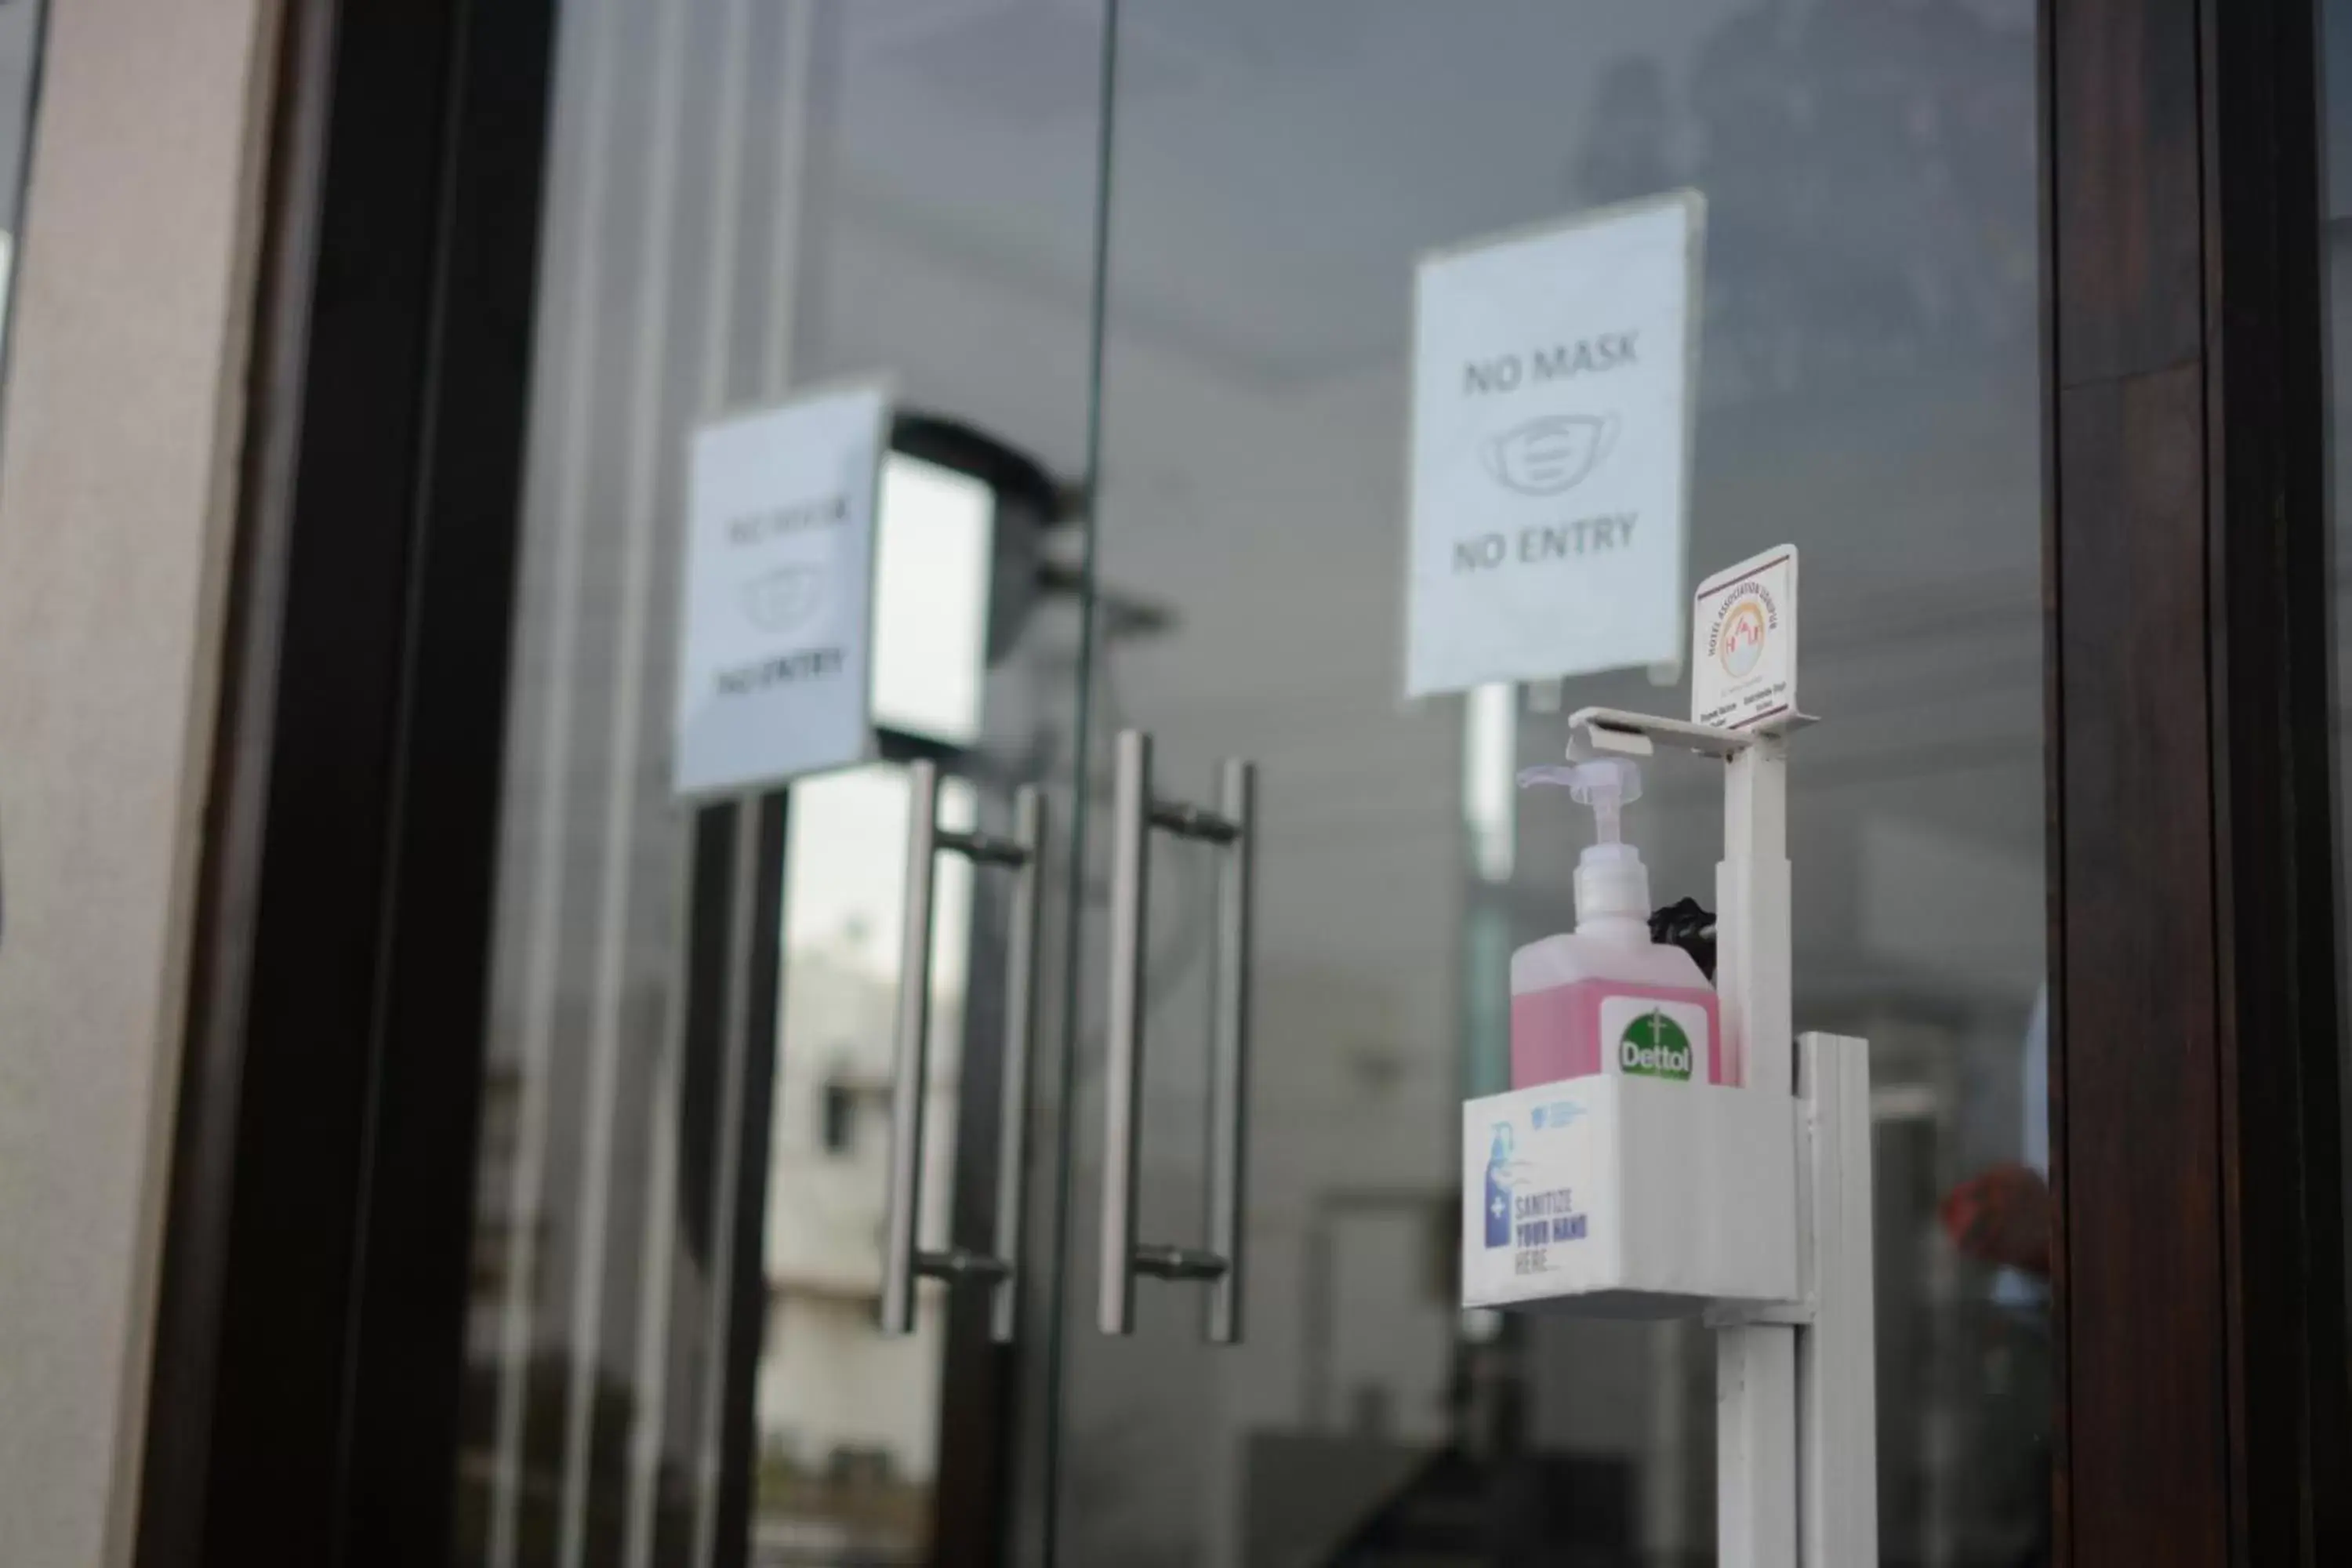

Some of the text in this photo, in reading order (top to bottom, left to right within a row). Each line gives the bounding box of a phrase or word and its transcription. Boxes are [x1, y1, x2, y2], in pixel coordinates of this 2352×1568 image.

[1464, 331, 1639, 396] NO MASK
[1453, 514, 1639, 573] NO ENTRY
[1622, 1041, 1690, 1072] Dettol
[1515, 1188, 1572, 1219] SANITIZE
[1516, 1214, 1588, 1248] YOUR HAND
